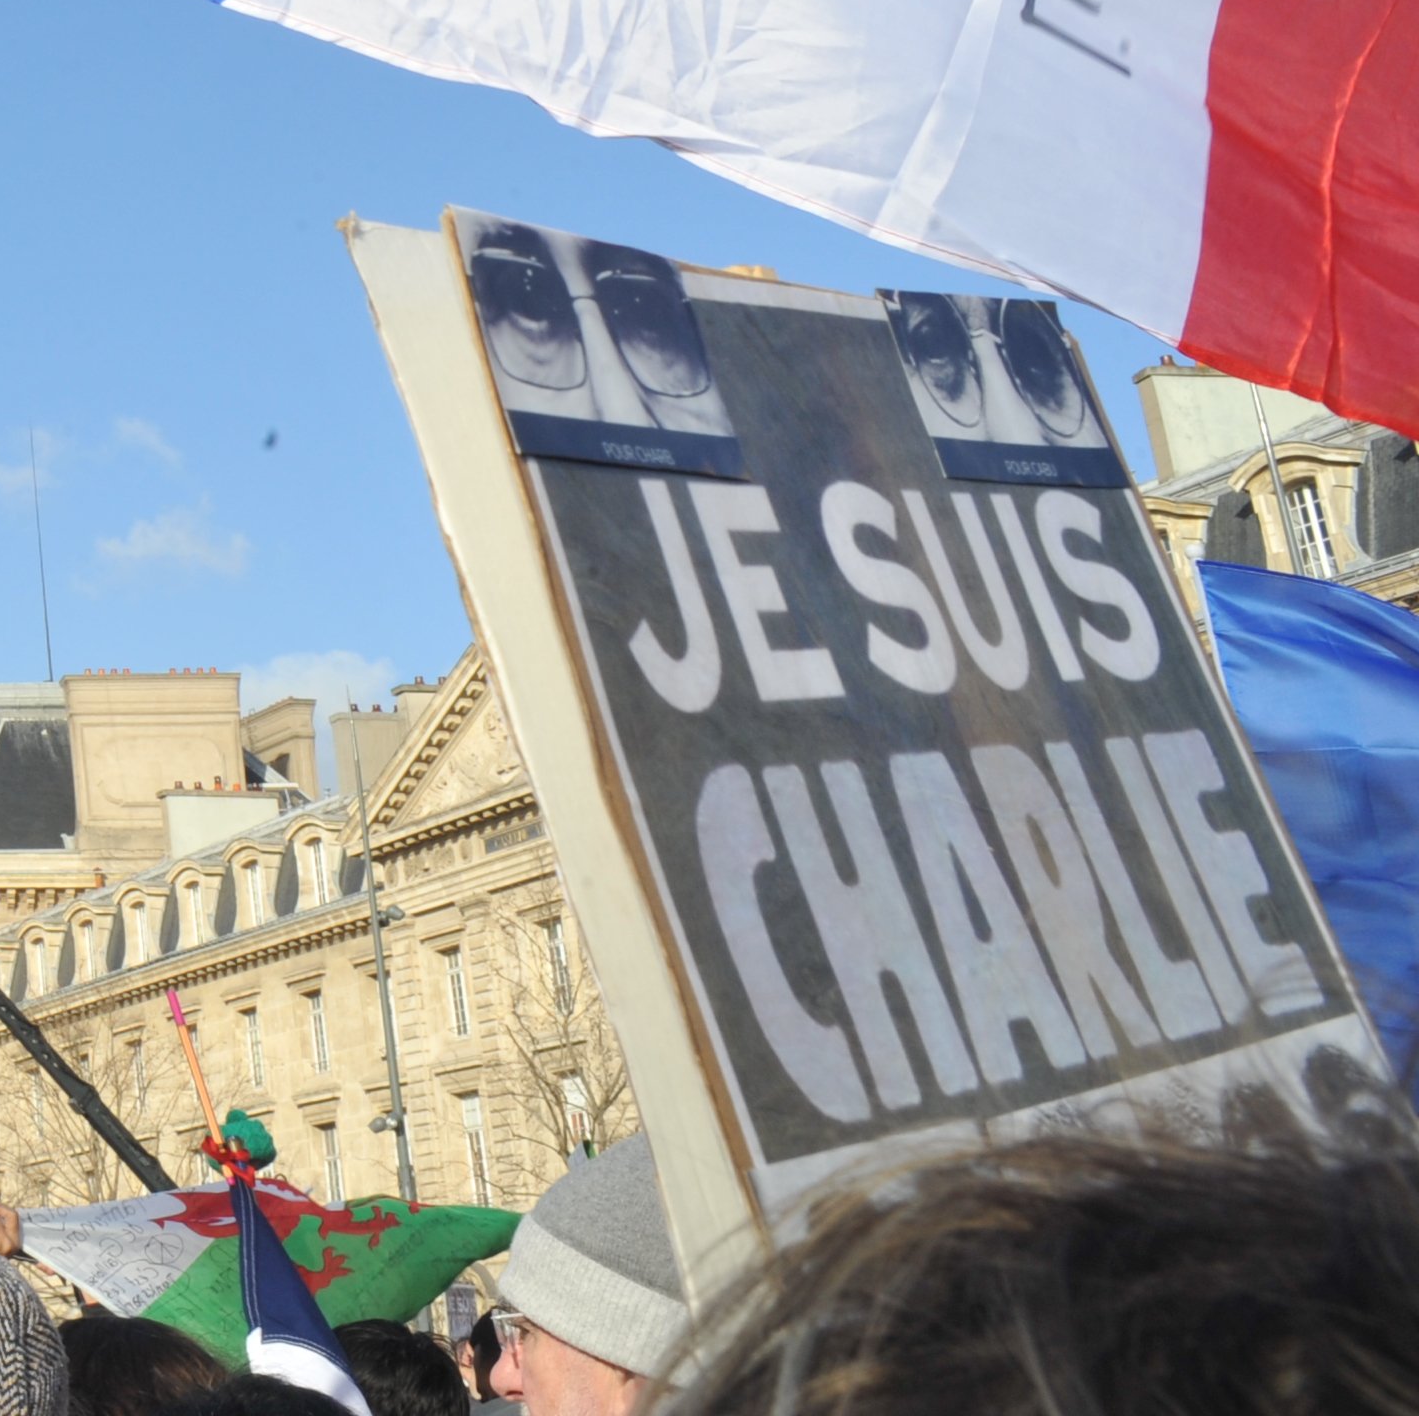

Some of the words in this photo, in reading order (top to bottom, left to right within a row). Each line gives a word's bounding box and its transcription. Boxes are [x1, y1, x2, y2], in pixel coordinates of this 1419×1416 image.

[627, 478, 845, 714] JE
[820, 478, 1163, 696] SUIS
[694, 729, 1326, 1125] CHARLIE
